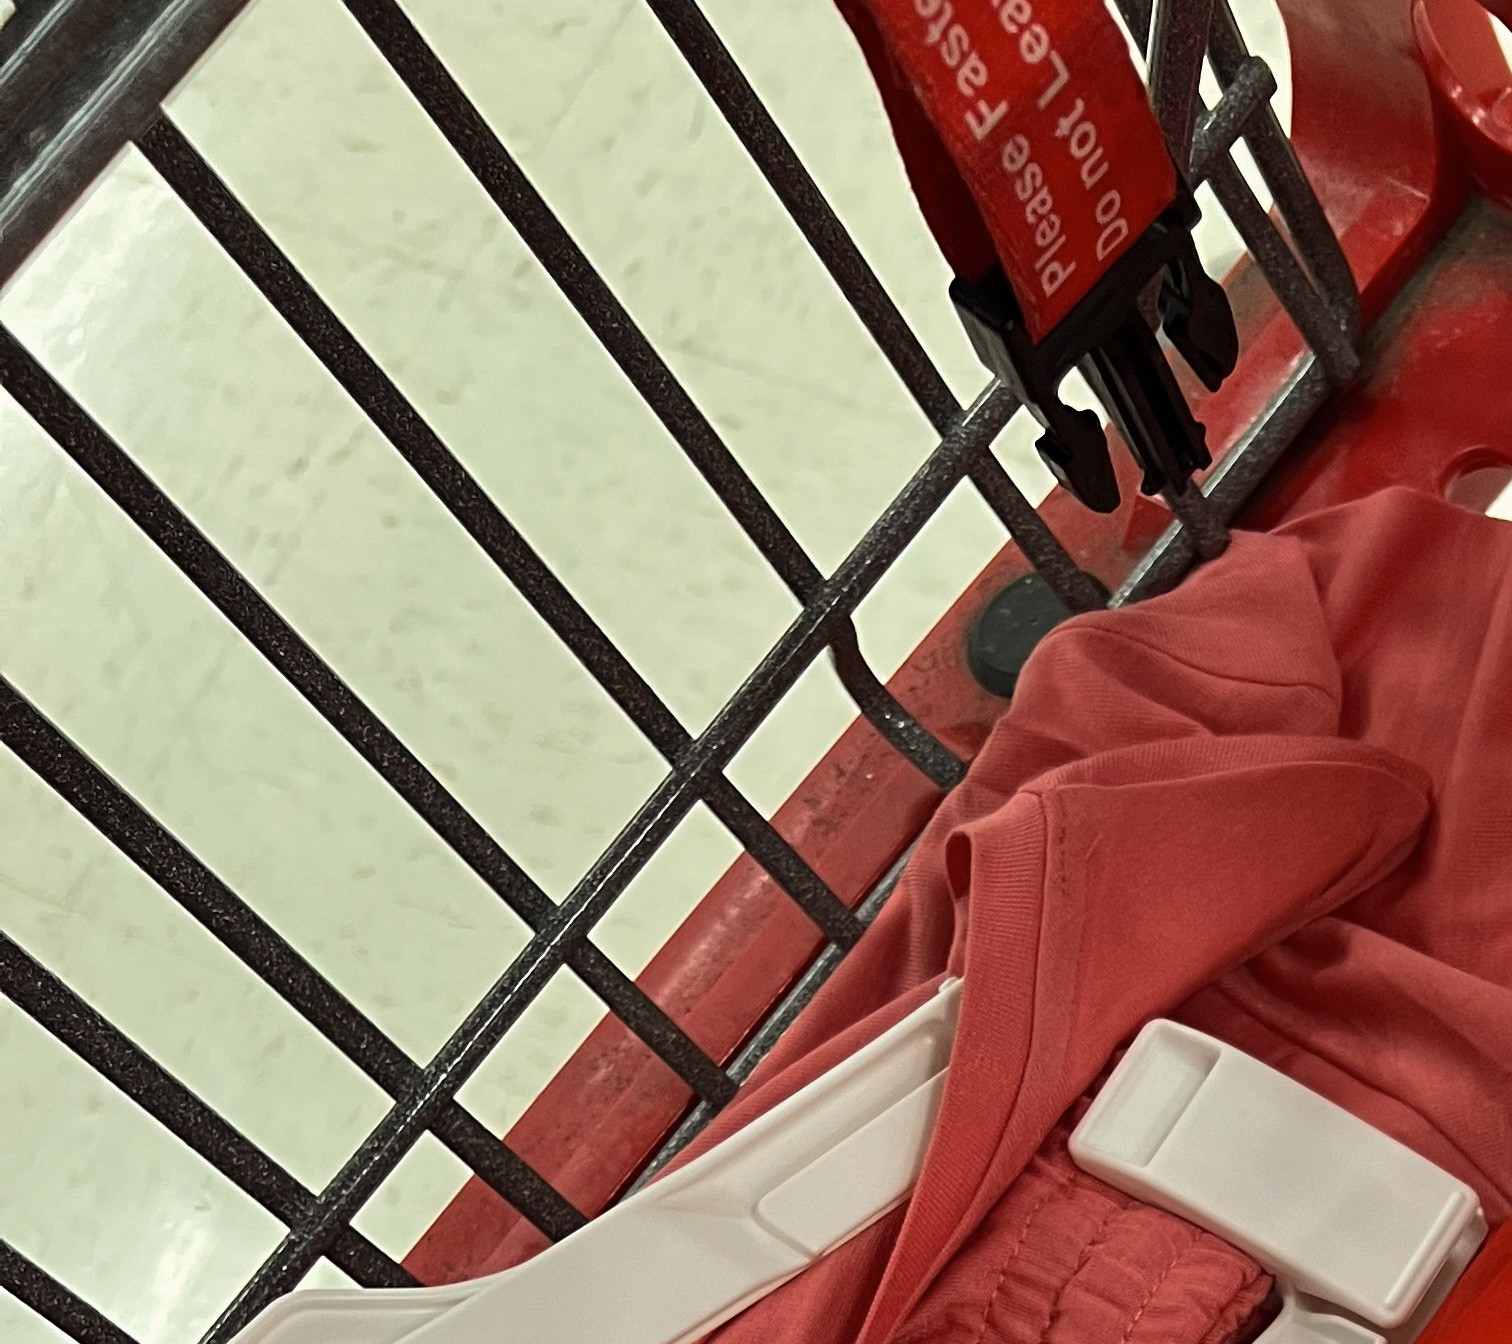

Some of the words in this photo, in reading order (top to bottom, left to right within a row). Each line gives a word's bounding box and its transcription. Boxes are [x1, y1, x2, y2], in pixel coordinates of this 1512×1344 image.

[991, 0, 1070, 111] Lea
[1056, 98, 1108, 190] not
[1001, 133, 1077, 297] Please
[1095, 193, 1130, 262] Do
